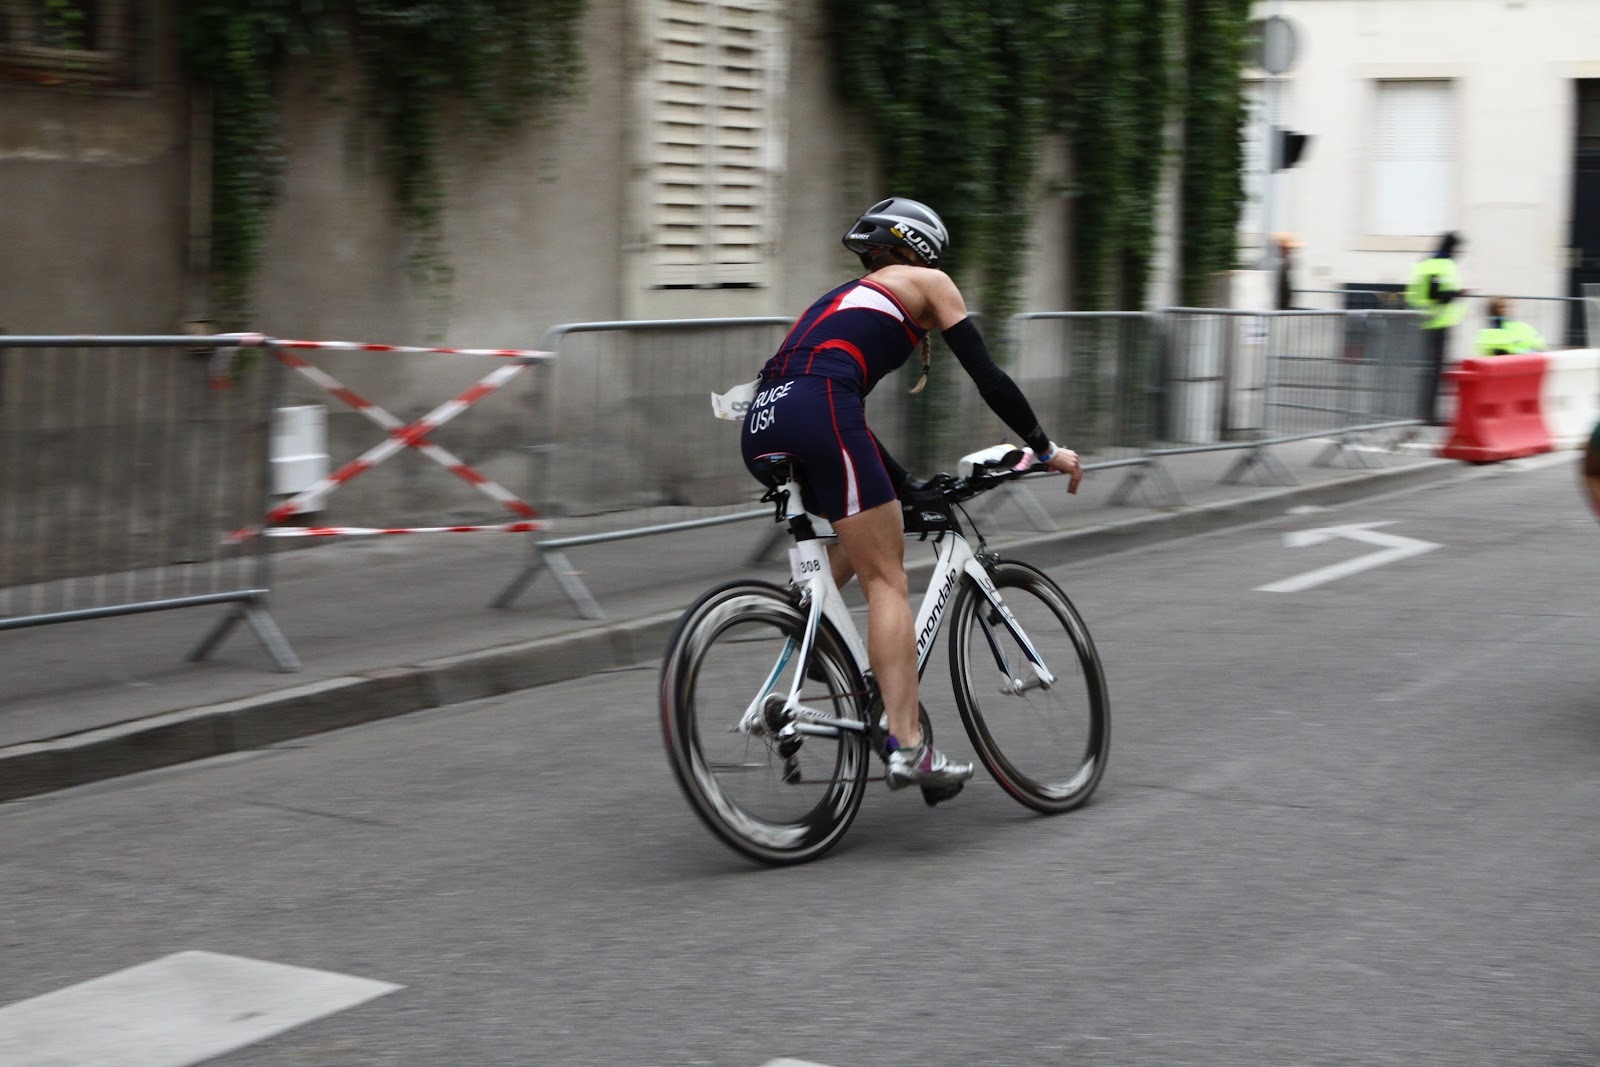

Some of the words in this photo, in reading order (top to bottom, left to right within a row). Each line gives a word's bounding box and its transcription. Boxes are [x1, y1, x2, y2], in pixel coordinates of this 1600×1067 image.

[894, 222, 938, 259] RUDY
[751, 380, 795, 411] RUGE
[750, 406, 775, 434] USA
[800, 559, 821, 574] 308
